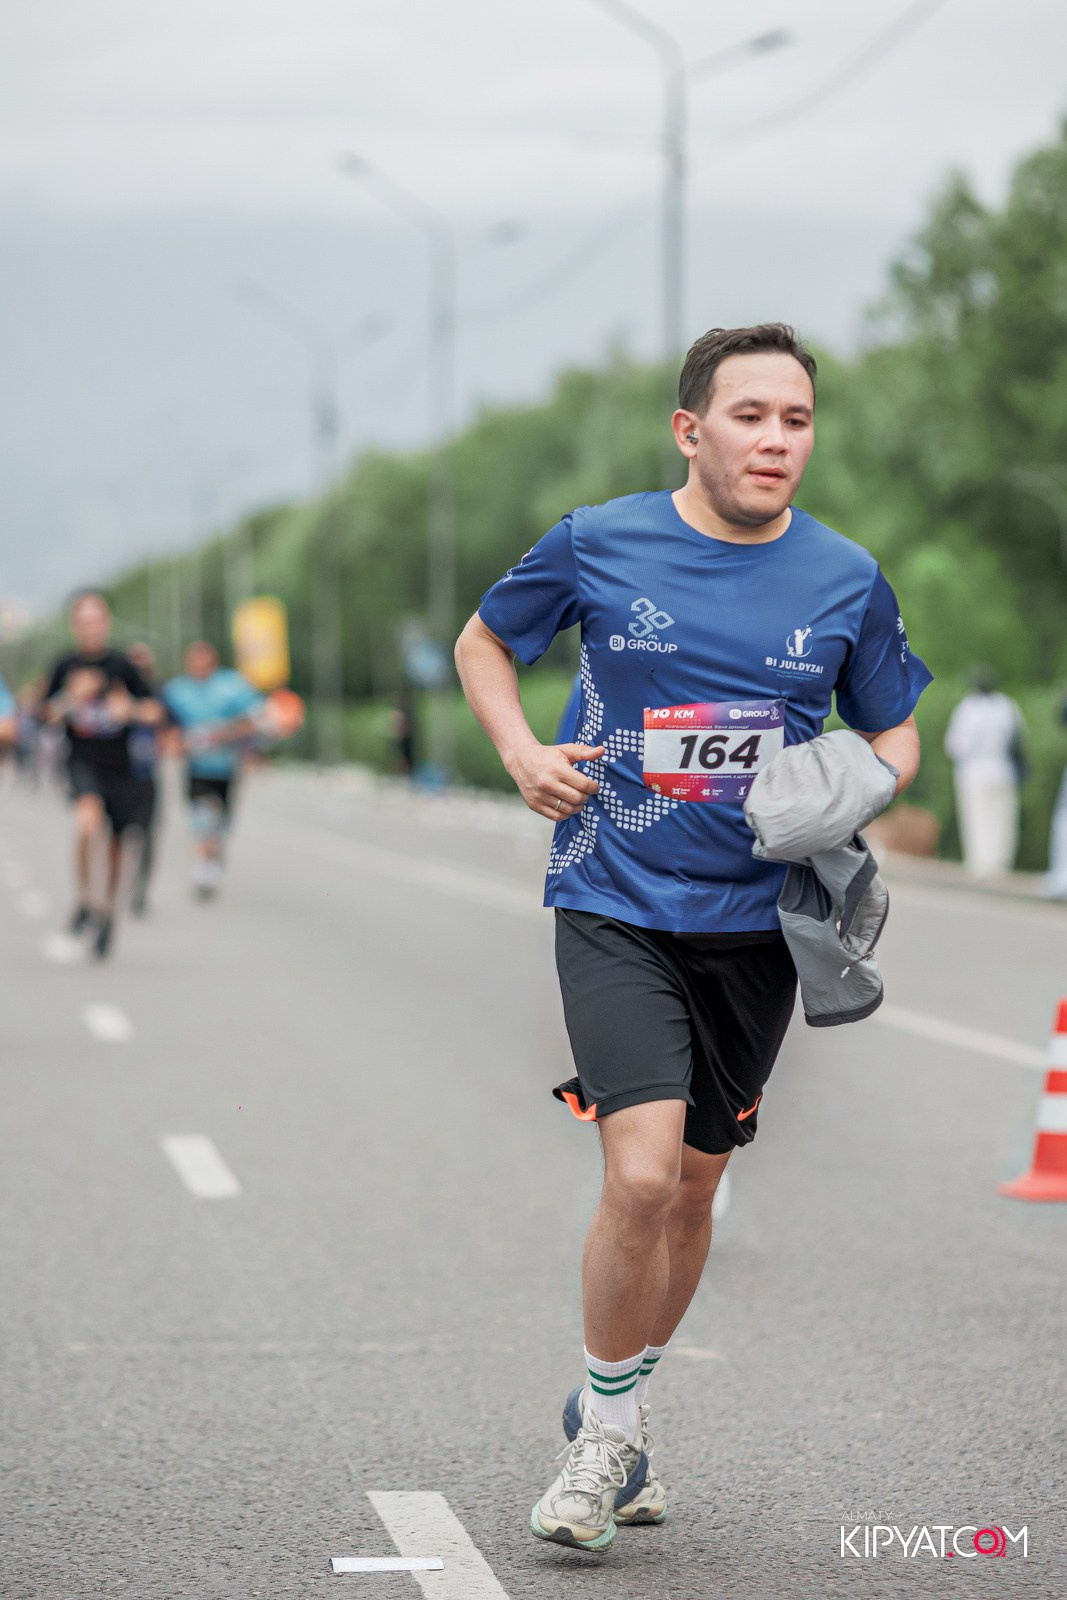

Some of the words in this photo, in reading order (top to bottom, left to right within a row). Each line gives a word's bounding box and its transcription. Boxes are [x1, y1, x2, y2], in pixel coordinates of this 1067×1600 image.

[627, 639, 678, 654] GROUP
[765, 656, 777, 667] BI
[779, 659, 824, 674] JULDYZAI
[652, 709, 670, 719] 10
[673, 709, 695, 719] KM
[742, 710, 770, 718] GROUP
[679, 734, 762, 770] 164
